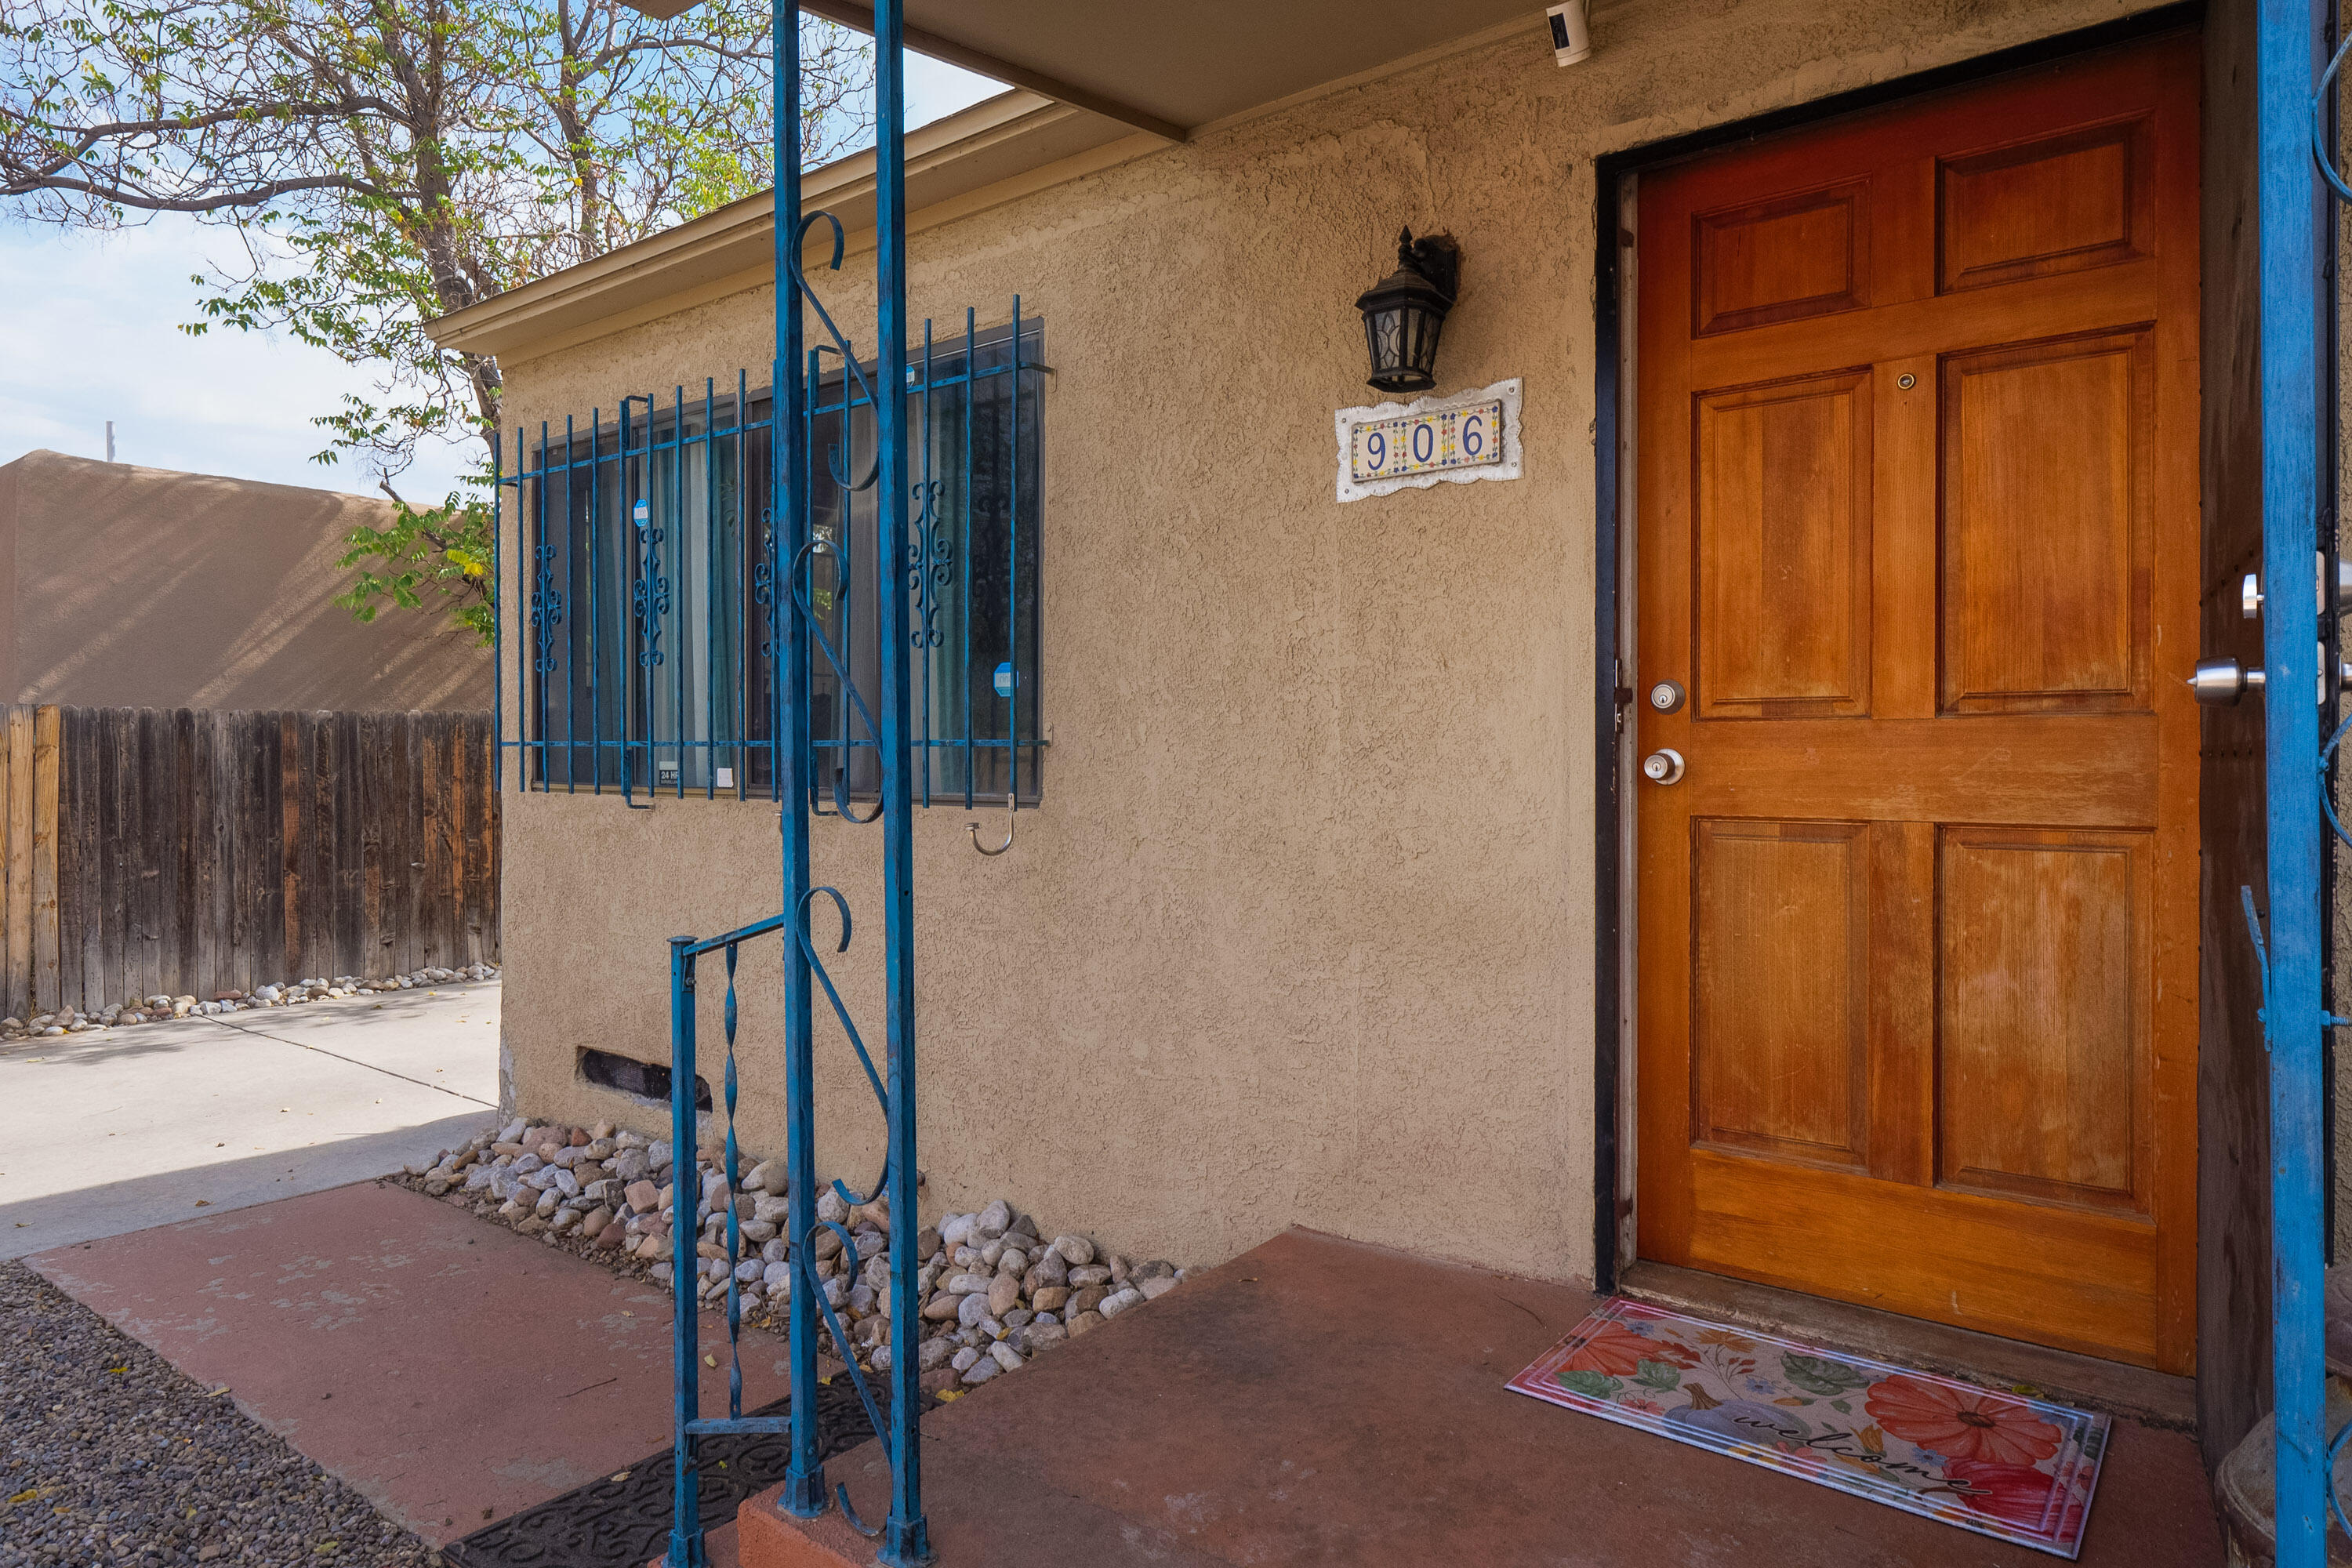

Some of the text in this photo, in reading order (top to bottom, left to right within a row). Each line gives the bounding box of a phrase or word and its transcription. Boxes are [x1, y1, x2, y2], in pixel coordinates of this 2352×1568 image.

[1367, 415, 1483, 470] 906
[661, 771, 670, 779] 24
[1733, 1416, 1992, 1494] welcome
